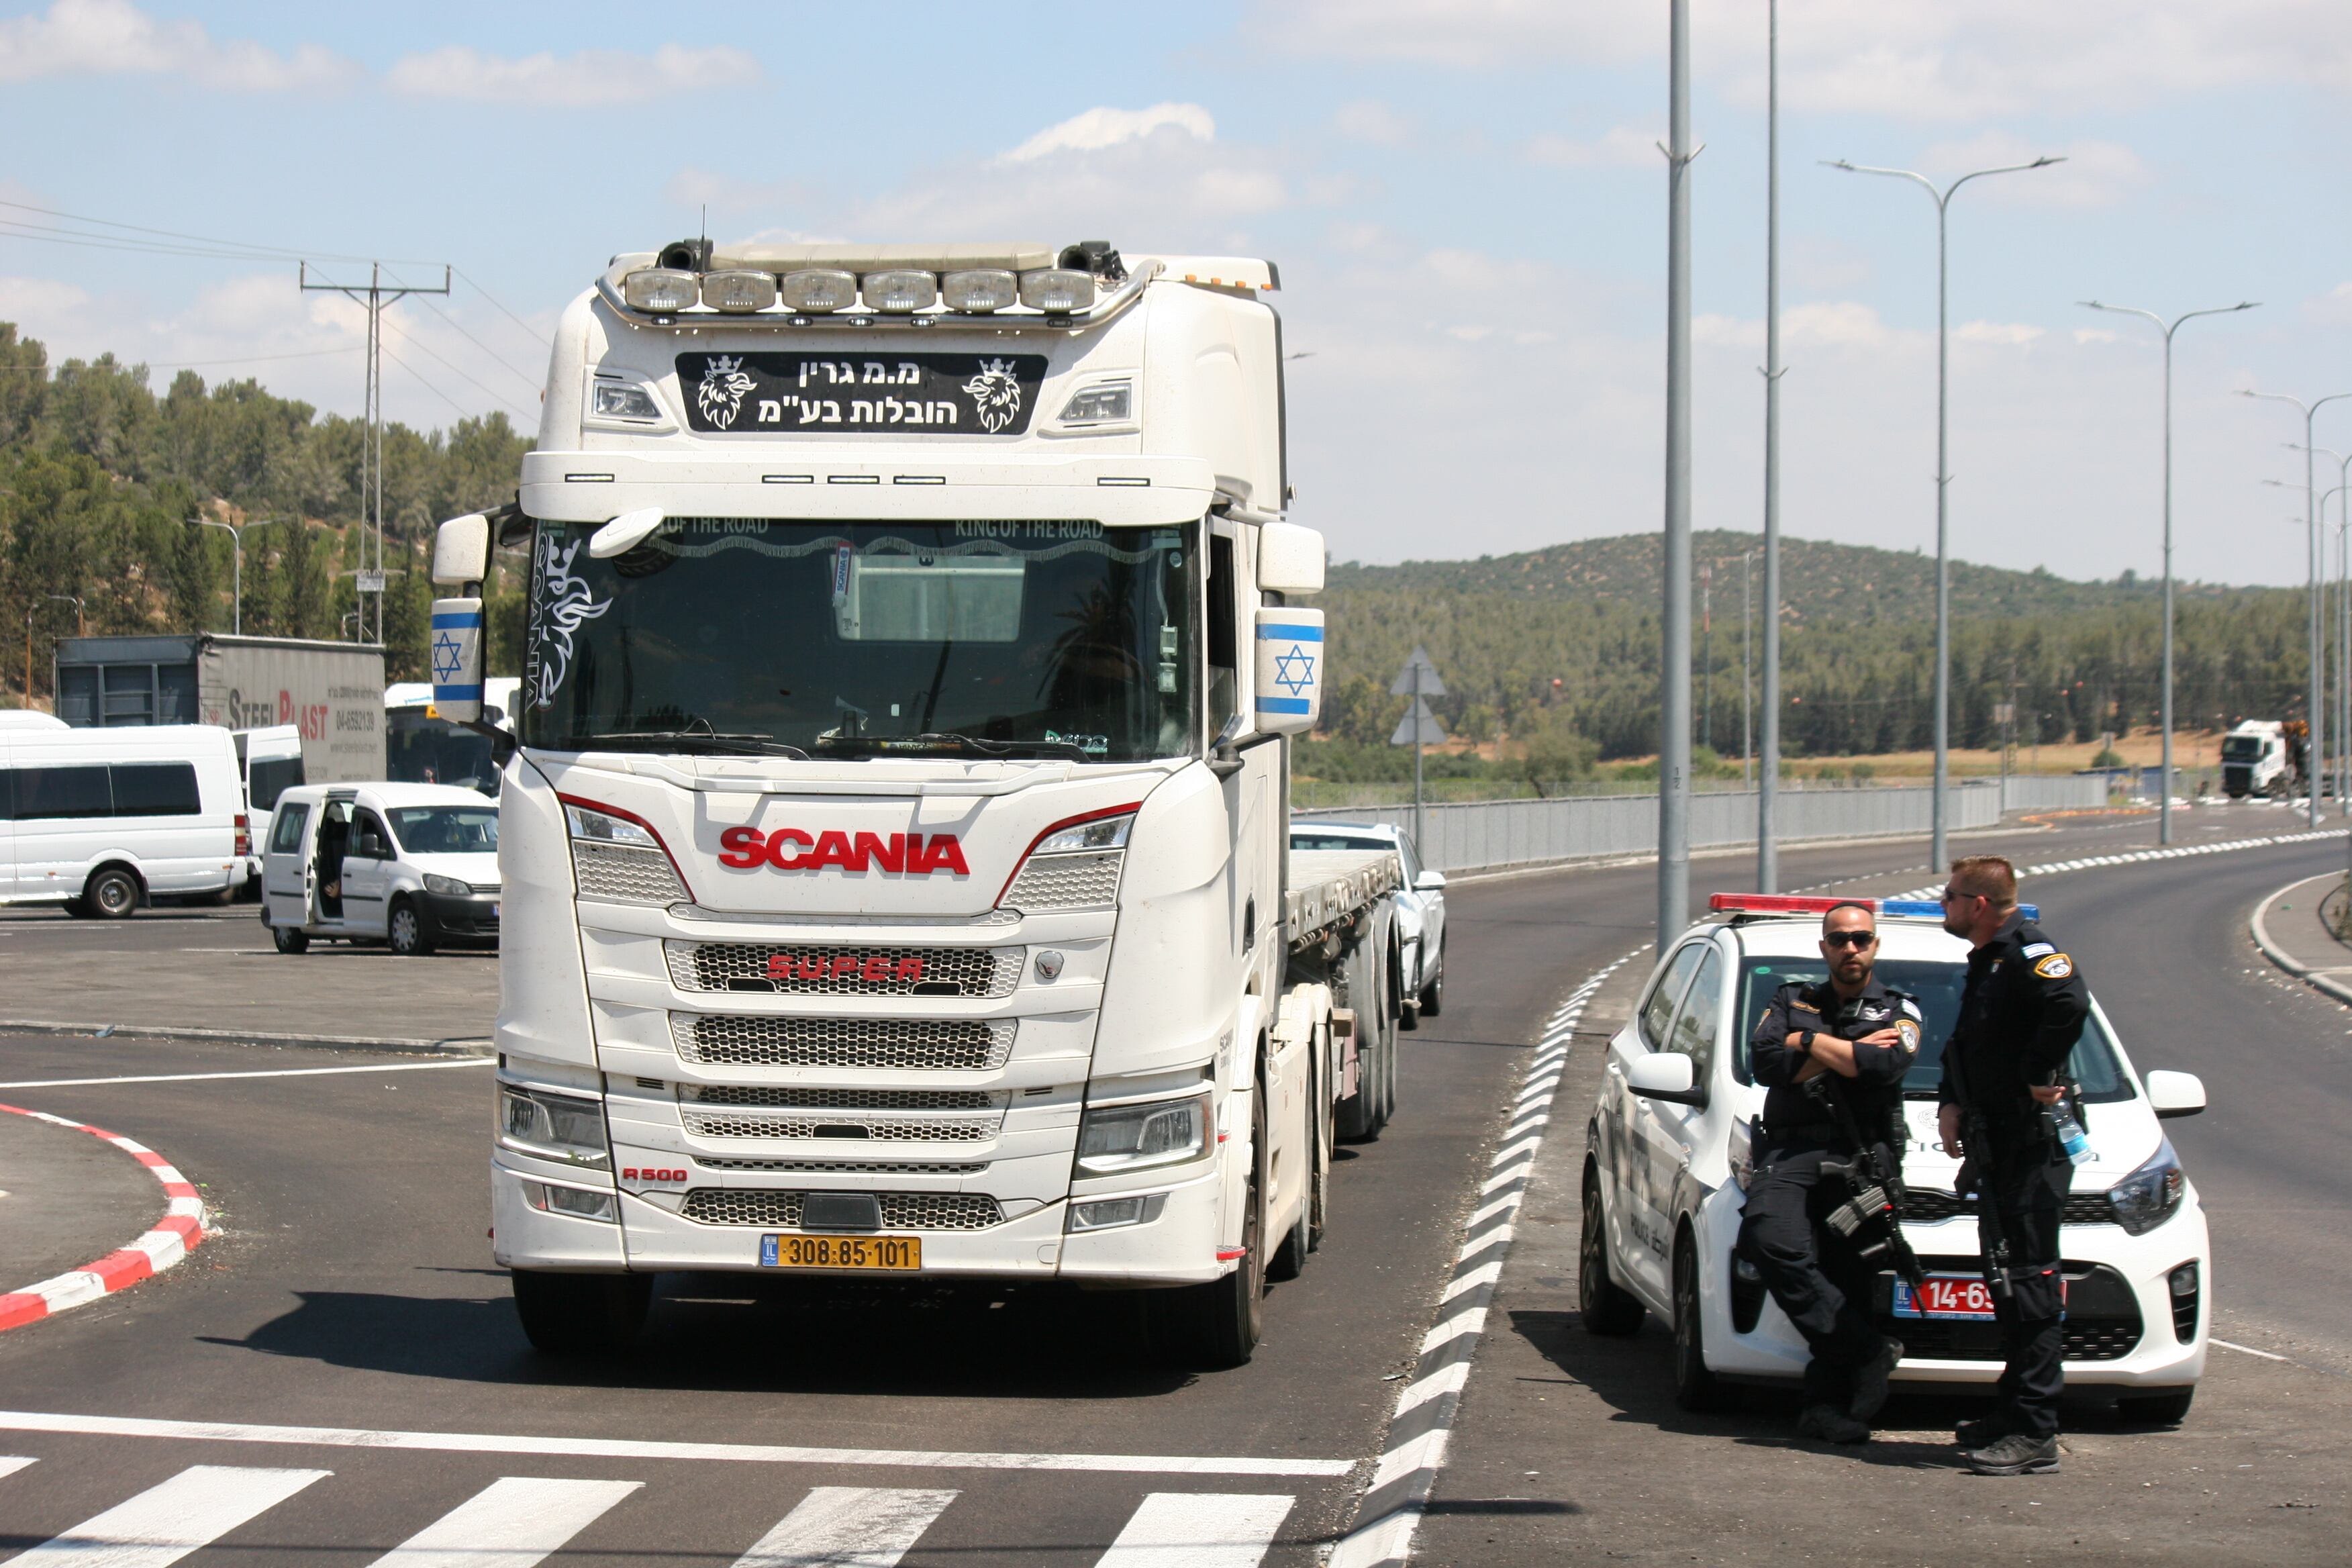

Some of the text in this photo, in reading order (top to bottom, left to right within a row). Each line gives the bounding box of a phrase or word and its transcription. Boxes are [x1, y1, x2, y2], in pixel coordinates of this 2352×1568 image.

[799, 362, 920, 387] מ.מ גרין
[758, 395, 957, 424] הובלות בע"מ
[724, 518, 769, 534] ROAD
[956, 520, 997, 536] KING
[1000, 520, 1020, 536] OF
[1059, 520, 1104, 538] ROAD
[837, 560, 847, 591] SCANIA
[524, 533, 548, 714] SCANIA
[718, 826, 971, 875] SCANIA
[767, 955, 924, 983] SUPER
[767, 1244, 776, 1257] IL
[1899, 1287, 1909, 1300] IL
